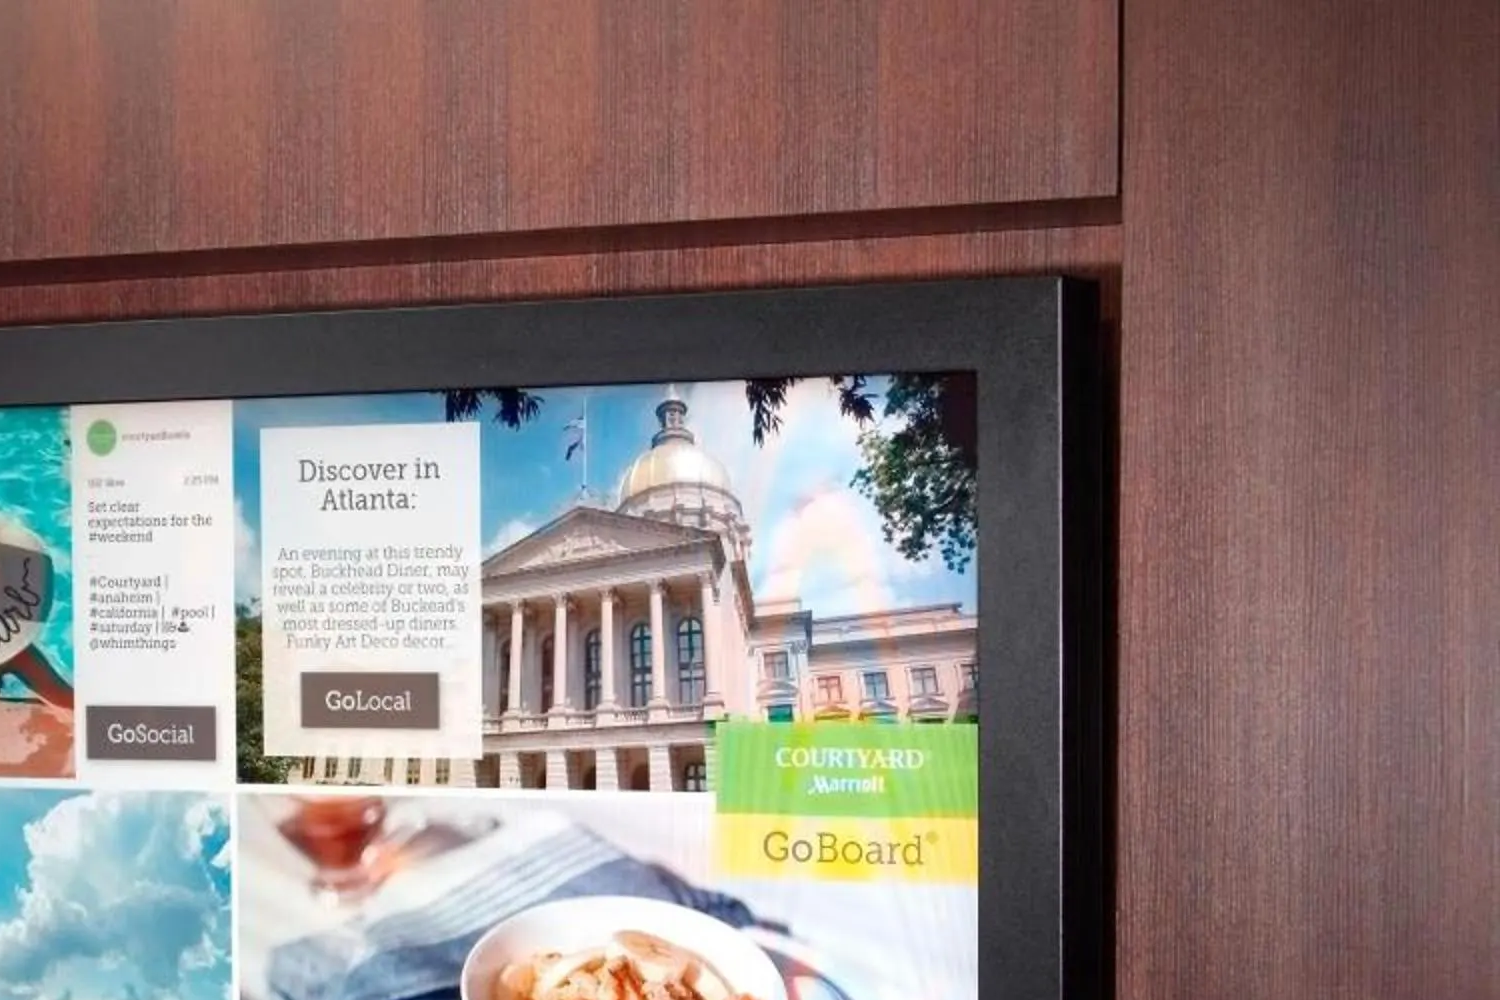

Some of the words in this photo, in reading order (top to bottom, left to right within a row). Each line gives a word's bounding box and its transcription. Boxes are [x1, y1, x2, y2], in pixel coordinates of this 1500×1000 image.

[298, 459, 408, 483] Discover
[415, 457, 441, 480] in
[87, 500, 107, 513] Set
[109, 500, 141, 513] clear
[320, 488, 418, 511] Atlanta:
[87, 515, 168, 530] expectations
[170, 514, 190, 527] for
[191, 513, 213, 527] the
[88, 530, 154, 543] #weekend
[277, 547, 299, 561] An
[303, 548, 361, 563] evening
[365, 547, 379, 560] at
[383, 545, 410, 560] this
[413, 544, 464, 562] trendy
[311, 564, 383, 579] Buckhead
[436, 565, 470, 581] may
[89, 575, 162, 590] #Courtyard
[273, 582, 315, 596] reveal
[319, 585, 328, 595] a
[331, 581, 393, 599] celebrity
[397, 583, 413, 595] or
[452, 582, 470, 595] as
[89, 606, 158, 619] #california
[171, 606, 209, 620] #pool
[277, 600, 306, 613] well
[309, 603, 325, 613] as
[329, 602, 368, 613] some
[372, 600, 388, 613] of
[89, 622, 153, 636] #saturday
[283, 618, 318, 631] most
[321, 616, 406, 635] dressed-up
[286, 634, 331, 652] Funky
[335, 635, 357, 649] Art
[361, 634, 399, 649] Deco
[325, 690, 412, 712] GoLocal
[107, 723, 195, 744] GoSocial
[775, 747, 924, 769] COURTYARD
[807, 774, 885, 796] Marriott
